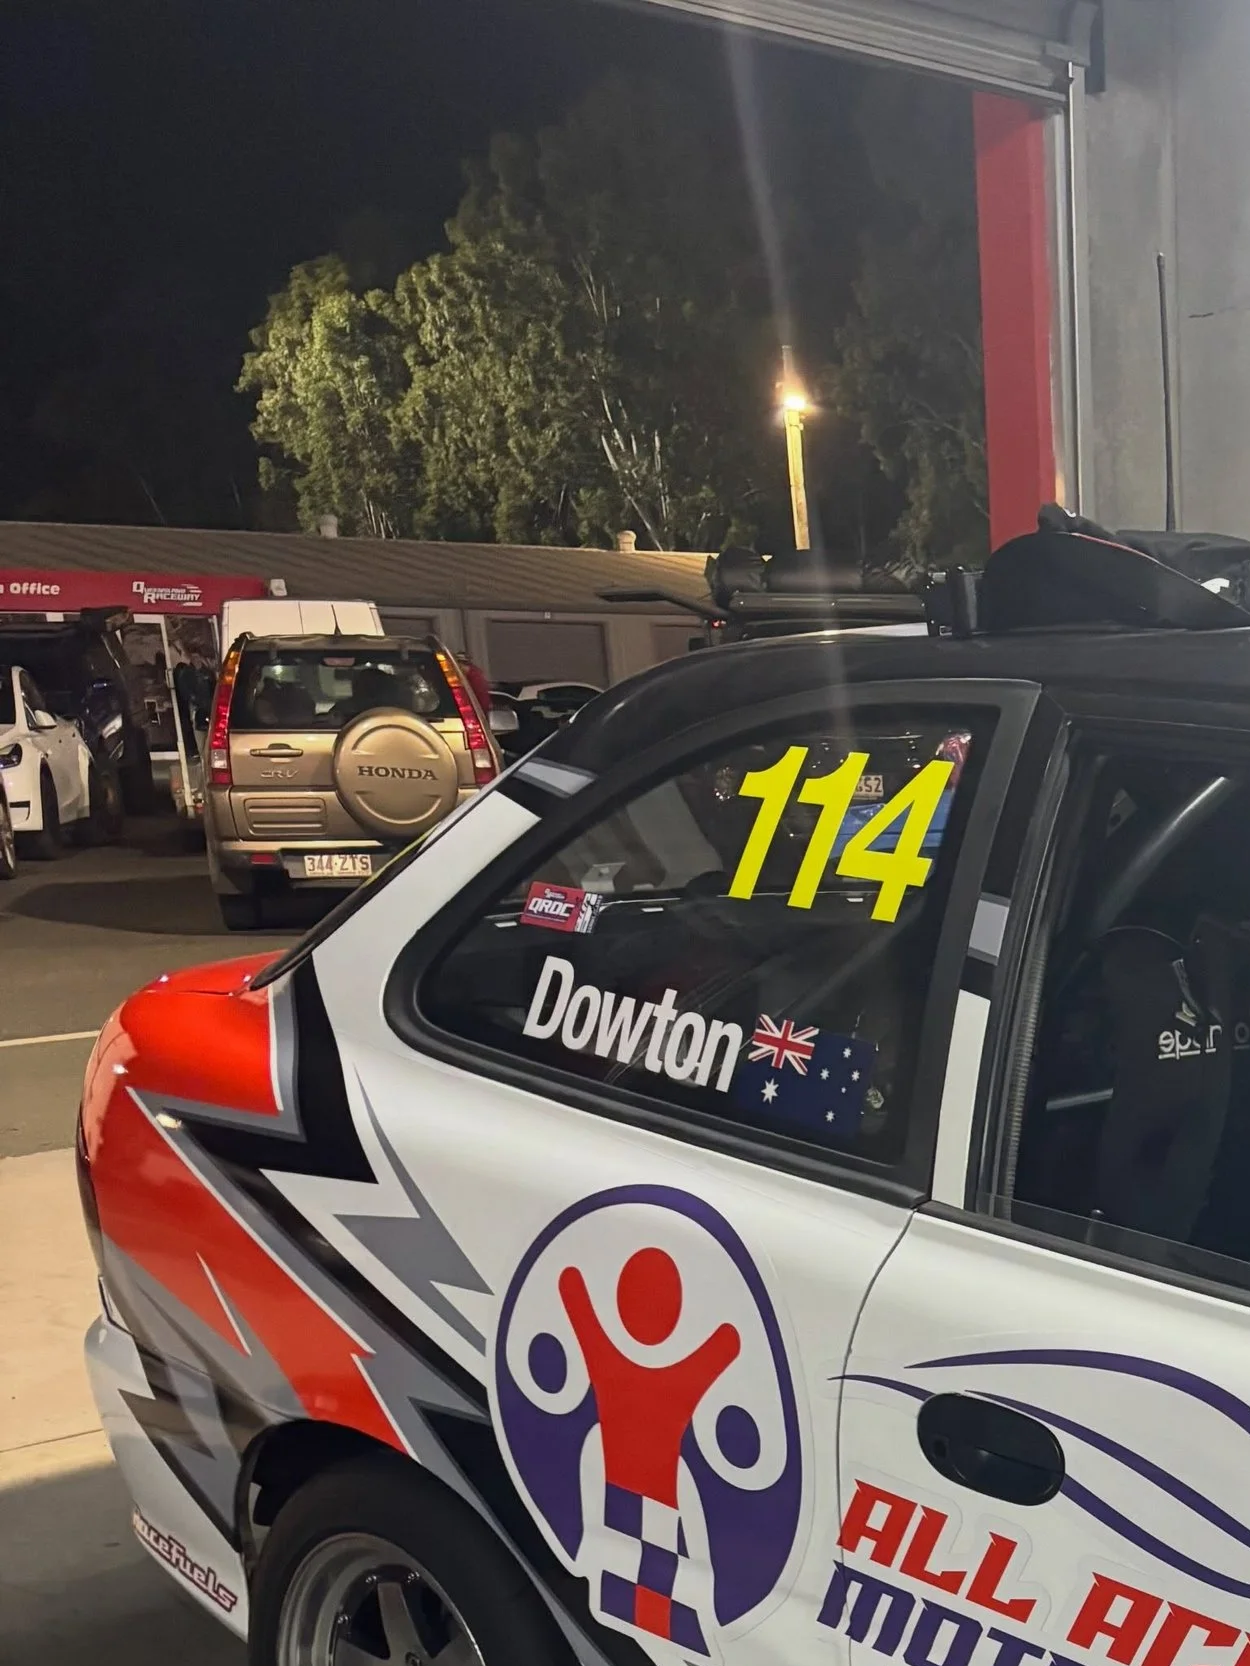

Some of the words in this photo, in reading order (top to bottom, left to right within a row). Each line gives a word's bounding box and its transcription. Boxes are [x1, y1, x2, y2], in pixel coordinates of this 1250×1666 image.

[10, 582, 61, 596] Office
[357, 766, 438, 781] HONDA
[727, 745, 955, 923] 114
[528, 897, 575, 917] QRDC
[523, 955, 743, 1093] Dowton
[836, 1479, 1037, 1622] ALL
